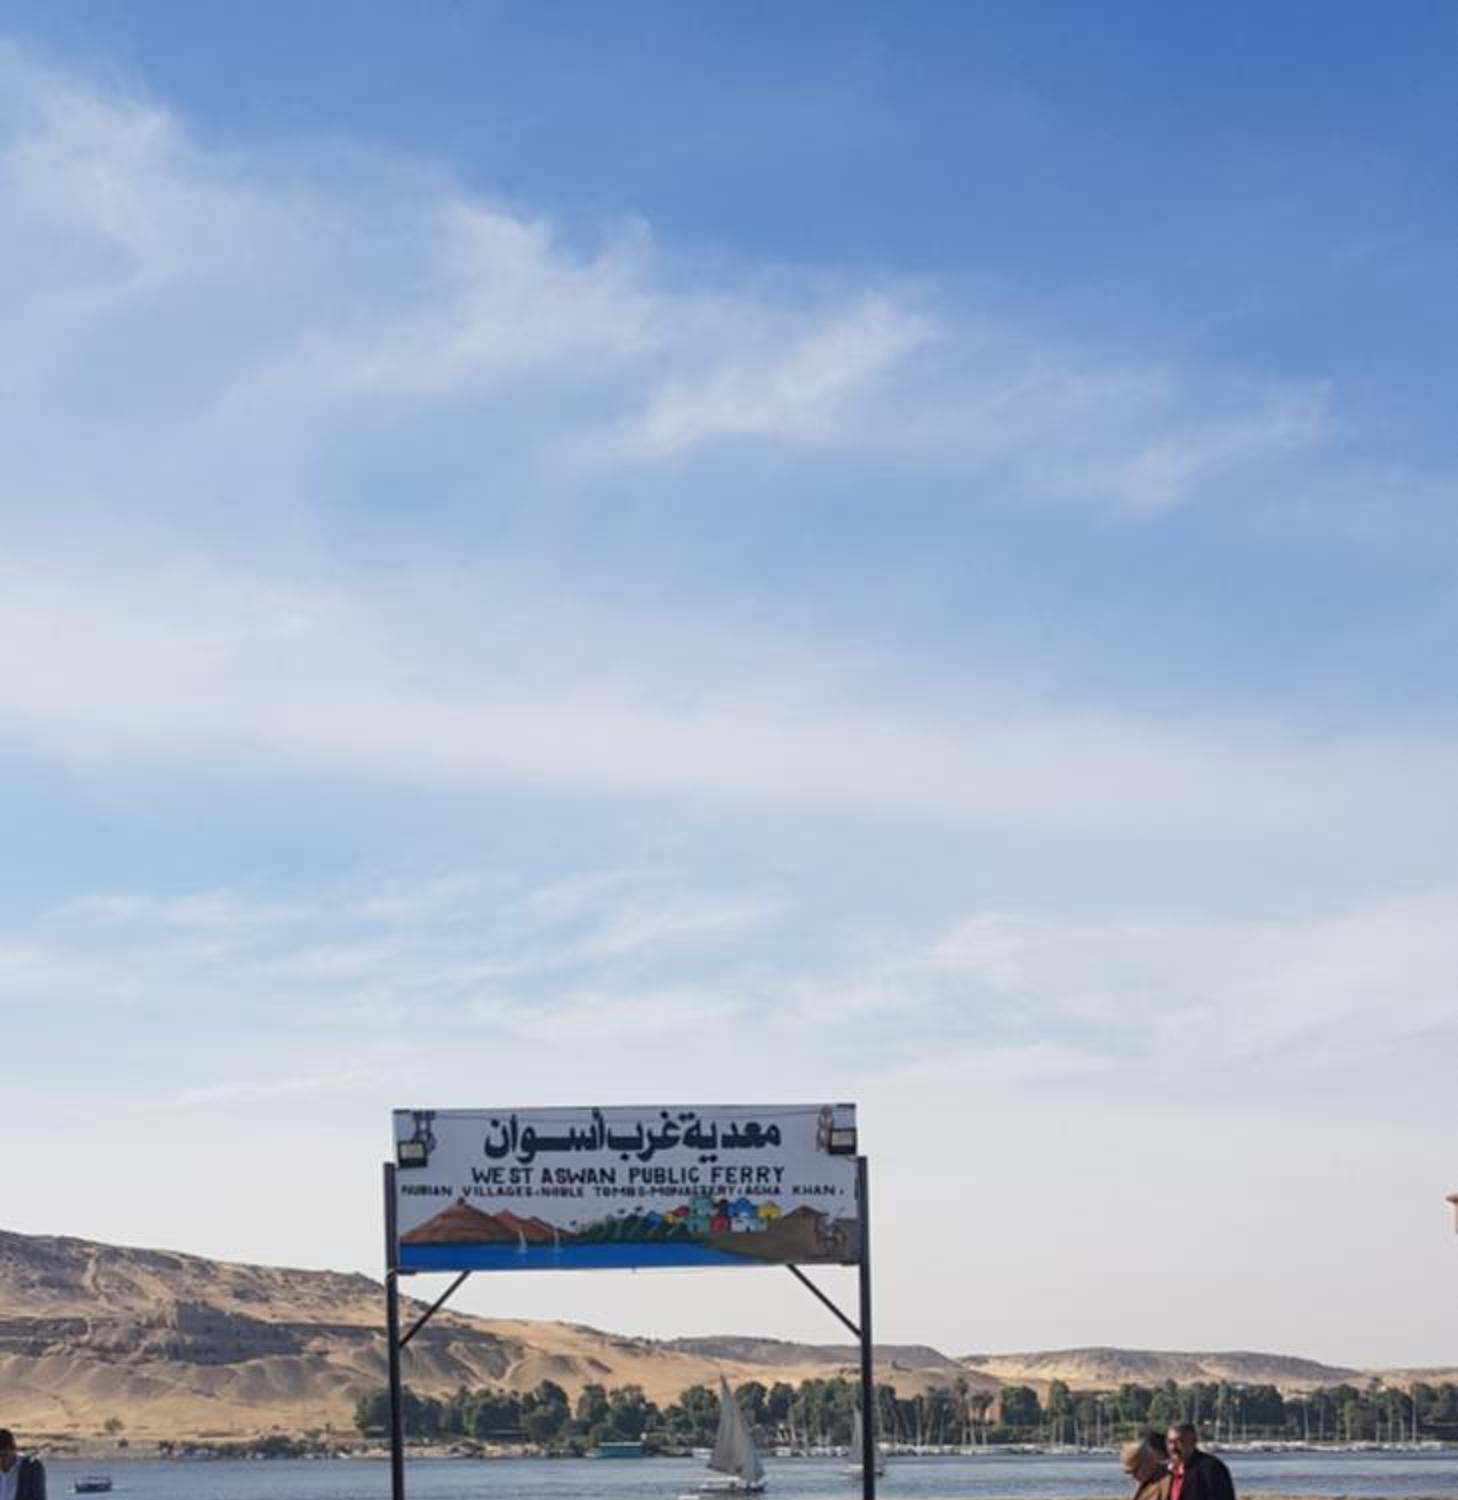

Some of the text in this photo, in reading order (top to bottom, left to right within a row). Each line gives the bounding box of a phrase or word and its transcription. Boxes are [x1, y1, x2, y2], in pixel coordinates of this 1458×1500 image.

[606, 1110, 681, 1163] غرب
[682, 1111, 782, 1164] معدية
[471, 1166, 785, 1185] WEST ASWAN PUBLIC FERRY
